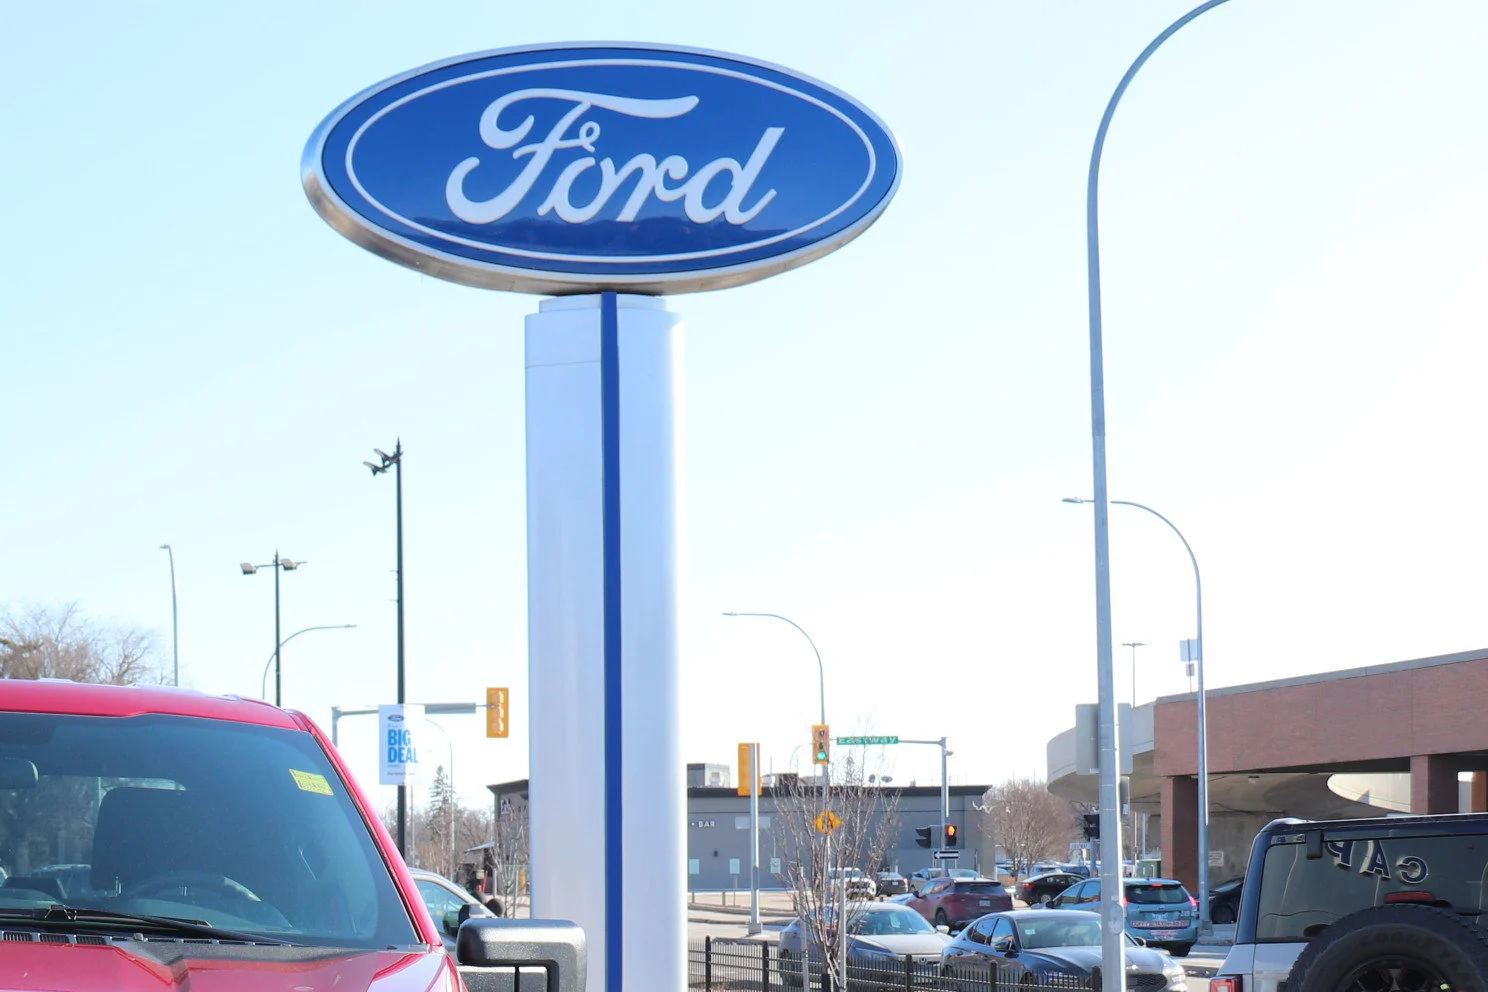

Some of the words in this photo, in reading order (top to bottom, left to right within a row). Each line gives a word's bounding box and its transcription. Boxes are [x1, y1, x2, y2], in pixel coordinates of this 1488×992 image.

[445, 88, 785, 226] Ford
[387, 729, 412, 746] BIG
[838, 736, 896, 744] Eastway
[387, 747, 420, 764] DEAL
[698, 820, 716, 828] BAR
